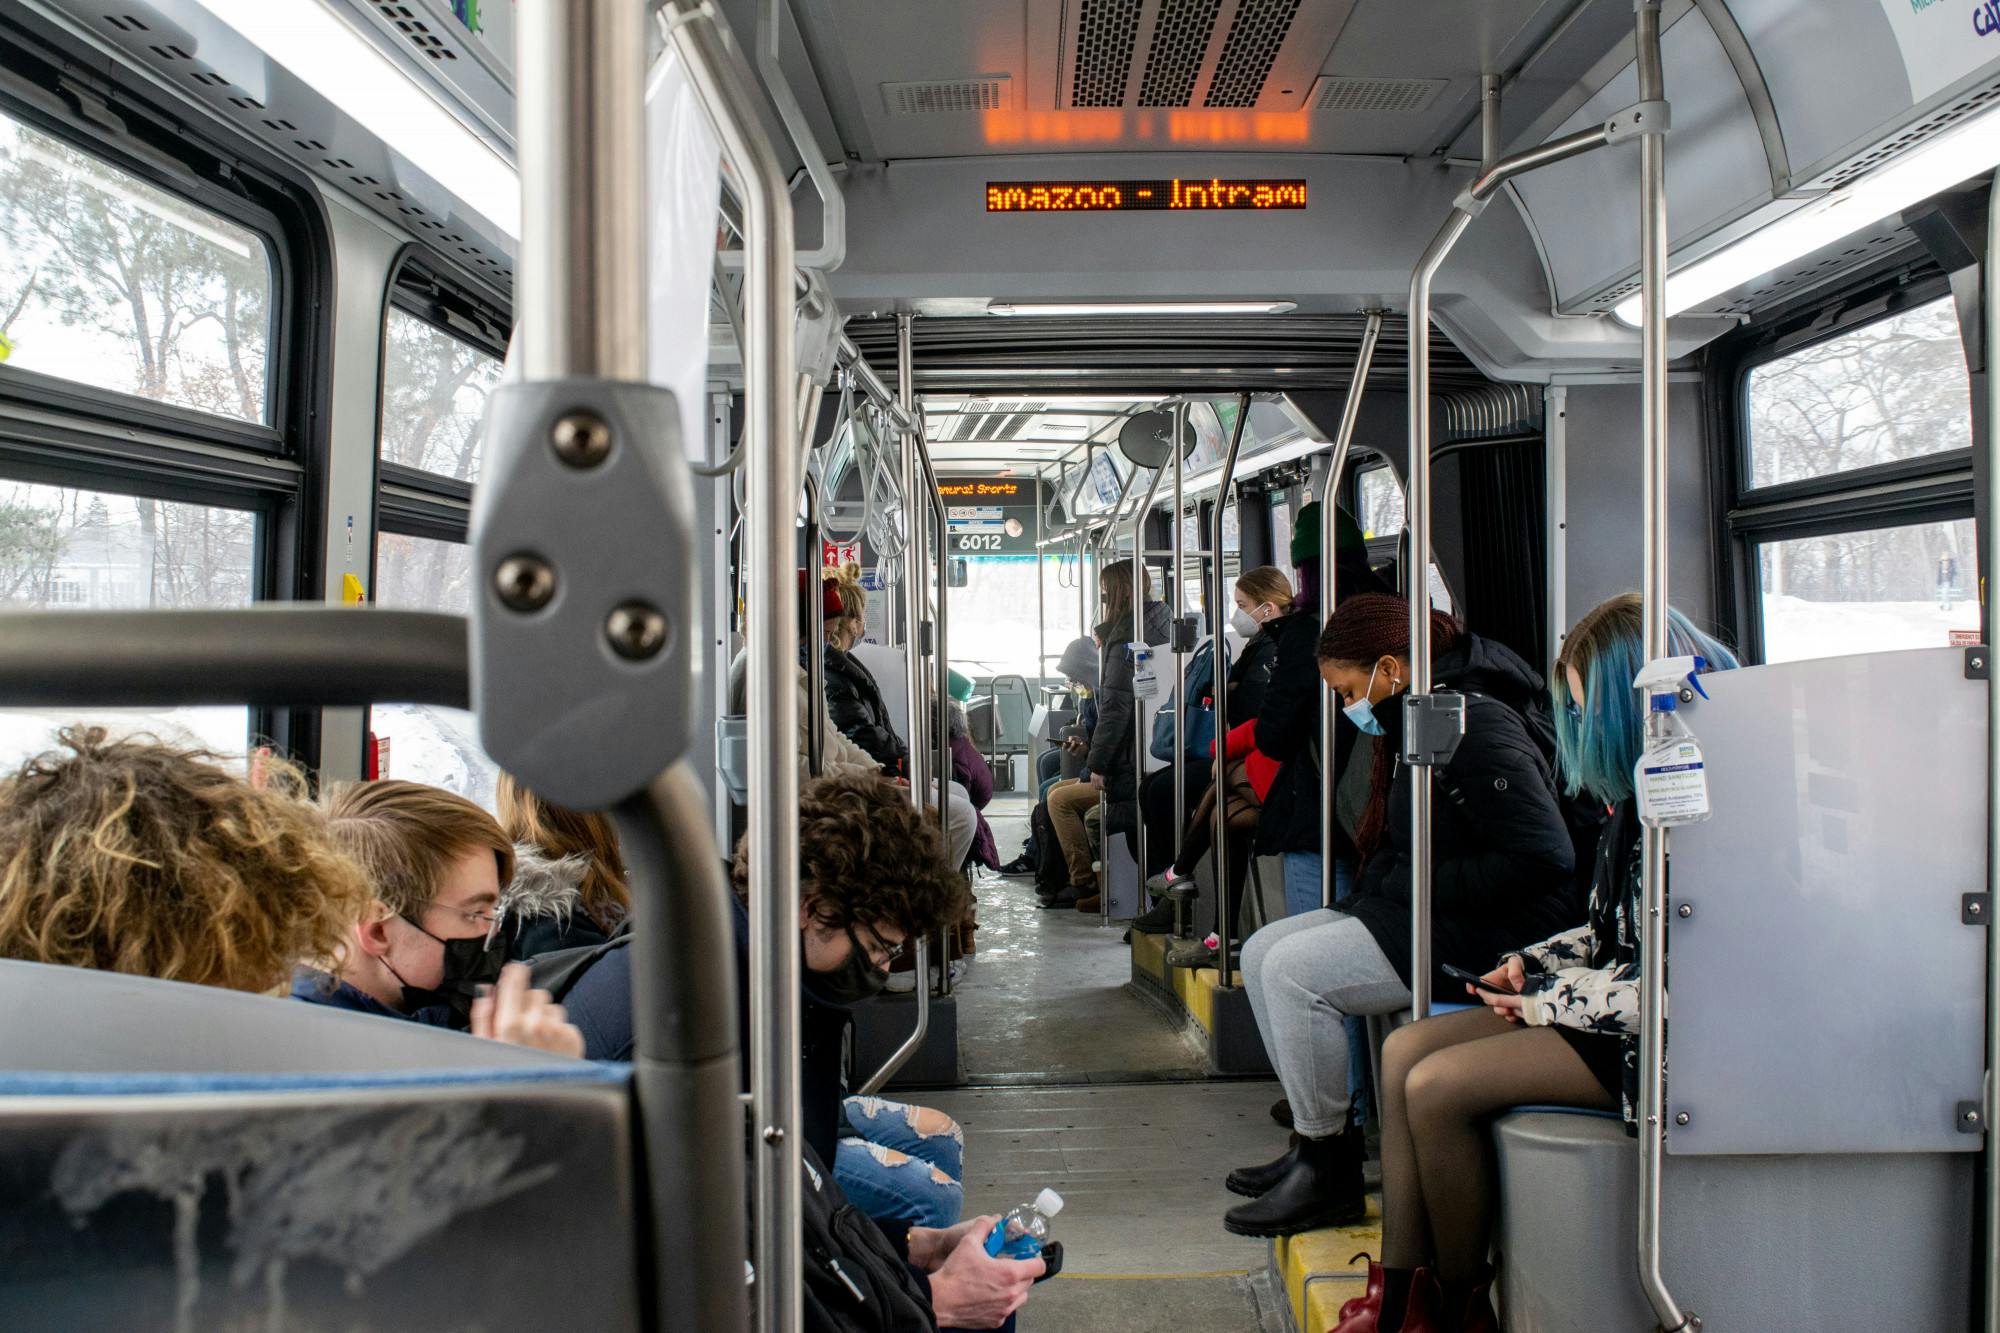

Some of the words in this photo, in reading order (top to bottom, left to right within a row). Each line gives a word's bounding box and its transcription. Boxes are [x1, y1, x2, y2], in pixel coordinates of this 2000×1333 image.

[1170, 178, 1305, 208] Intram
[977, 484, 1018, 495] Sports
[959, 535, 1002, 550] 6012
